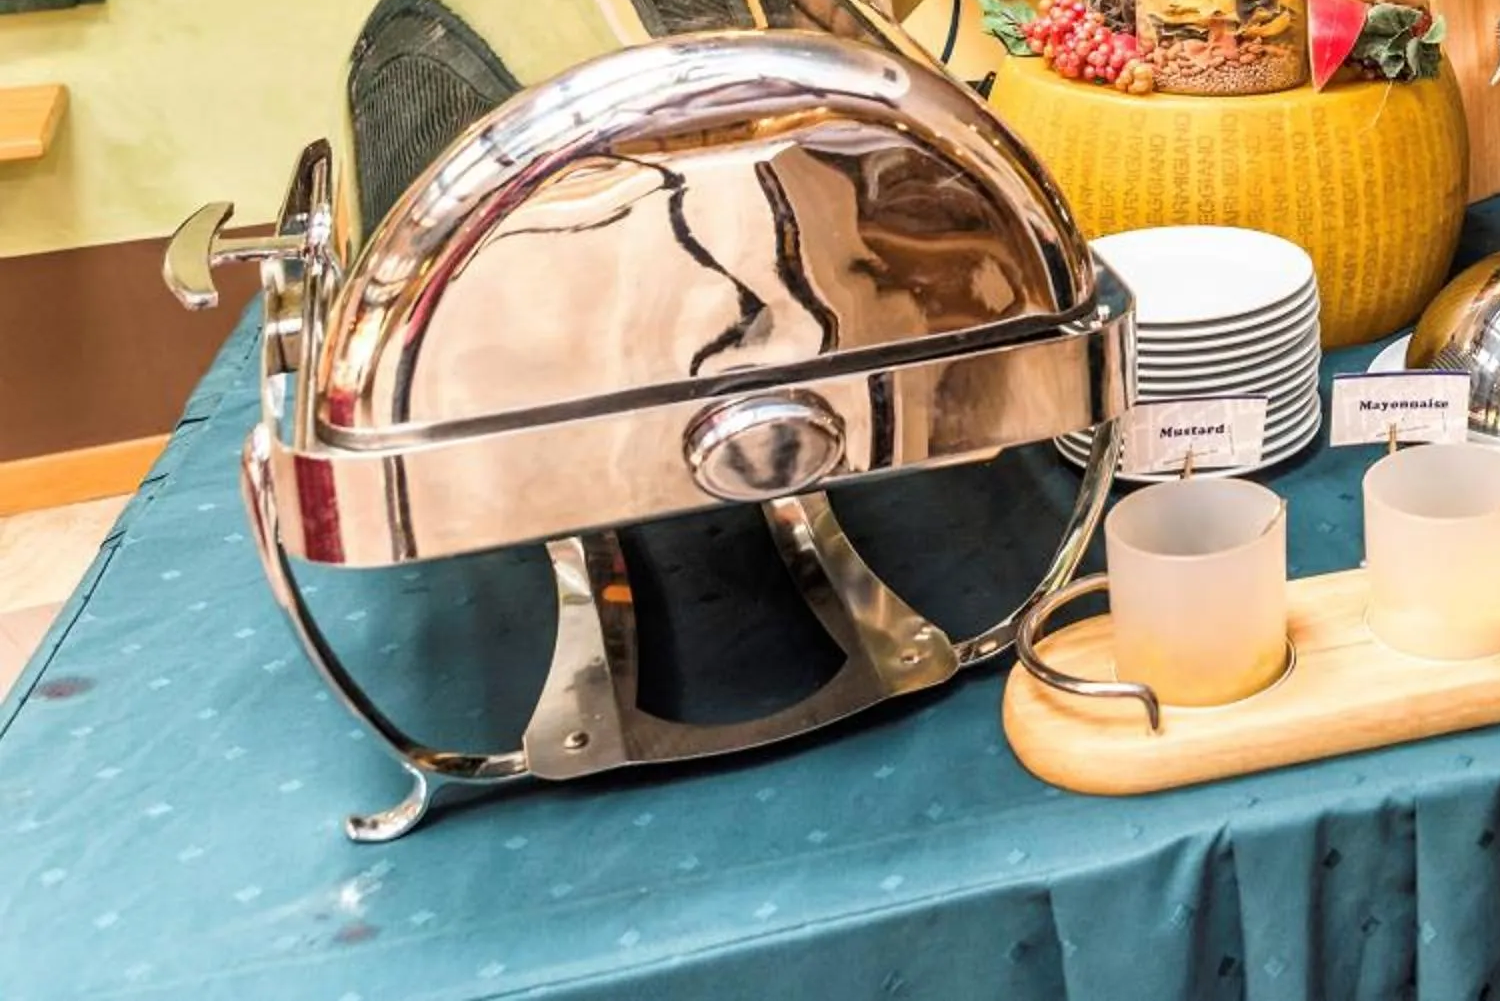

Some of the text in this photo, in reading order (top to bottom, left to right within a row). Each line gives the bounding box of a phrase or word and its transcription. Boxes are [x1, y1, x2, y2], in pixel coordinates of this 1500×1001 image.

[1145, 135, 1167, 226] EGGIANO
[1170, 112, 1191, 226] ARMIGIANO
[1196, 135, 1216, 226] EGGIANO
[1160, 423, 1225, 438] Mustard
[1359, 399, 1449, 411] Mayonnaise
